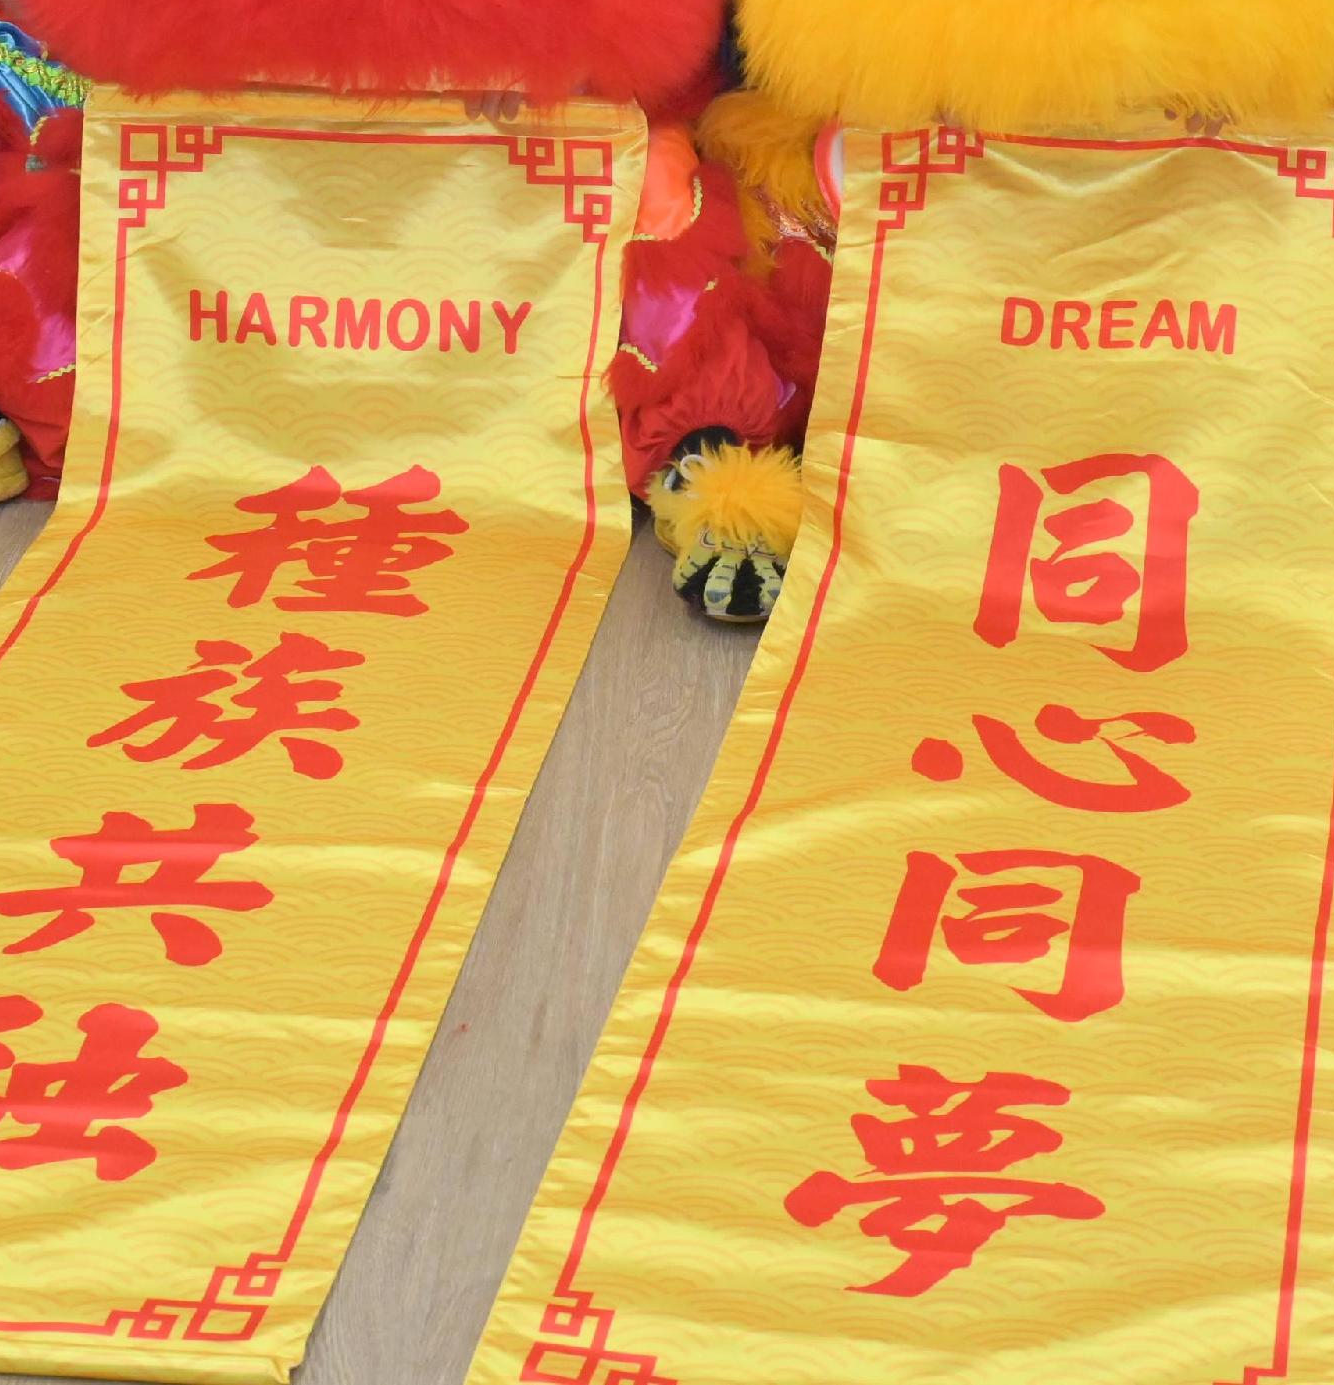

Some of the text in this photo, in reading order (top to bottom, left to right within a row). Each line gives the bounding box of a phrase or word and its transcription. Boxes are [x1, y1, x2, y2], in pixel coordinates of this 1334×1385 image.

[189, 289, 532, 355] HARMONY
[1000, 296, 1236, 355] DREAM
[784, 453, 1199, 1298] 同心同夢
